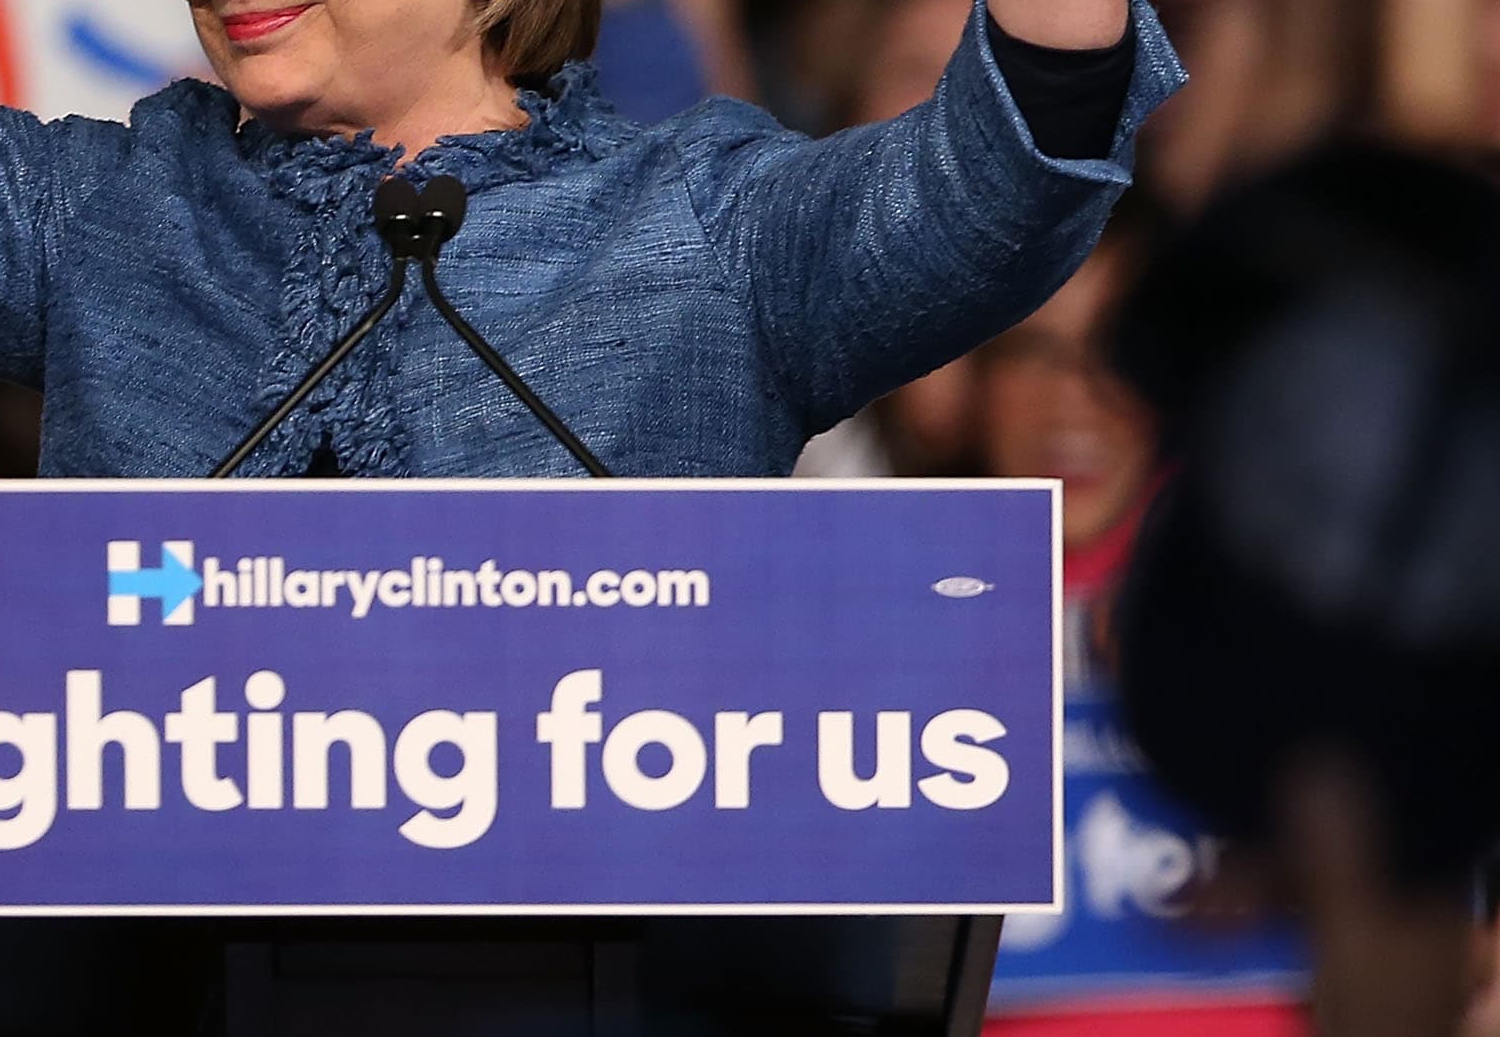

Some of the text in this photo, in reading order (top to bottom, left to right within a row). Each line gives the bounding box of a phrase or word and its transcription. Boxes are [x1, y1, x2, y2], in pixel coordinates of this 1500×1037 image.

[203, 556, 711, 618] hillaryclinton.com
[535, 668, 784, 810] for
[817, 708, 1010, 810] us
